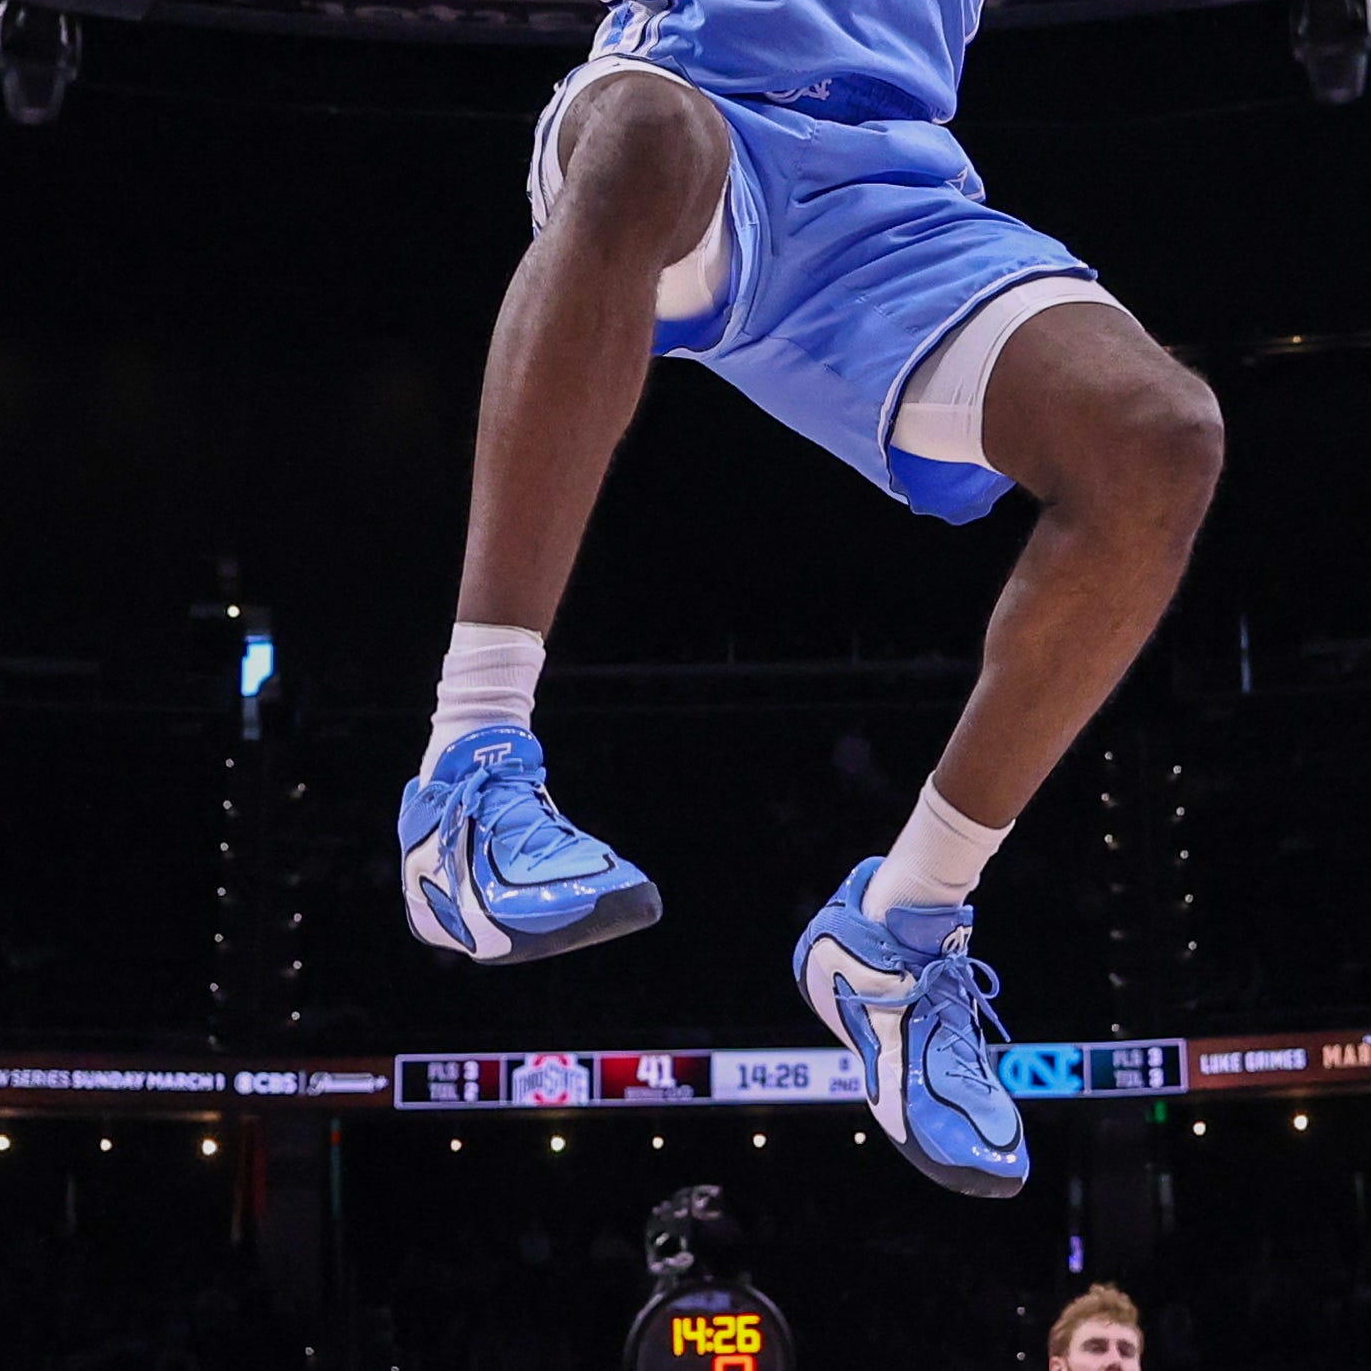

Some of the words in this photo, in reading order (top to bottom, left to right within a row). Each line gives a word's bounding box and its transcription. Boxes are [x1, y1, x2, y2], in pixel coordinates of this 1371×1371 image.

[10, 1069, 71, 1089] SERIES
[71, 1070, 146, 1091] SUNDAY
[145, 1072, 215, 1092] MARCH
[253, 1071, 297, 1095] CBS
[636, 1054, 677, 1088] 41
[736, 1063, 810, 1090] 14:26
[672, 1314, 762, 1357] 14:26
